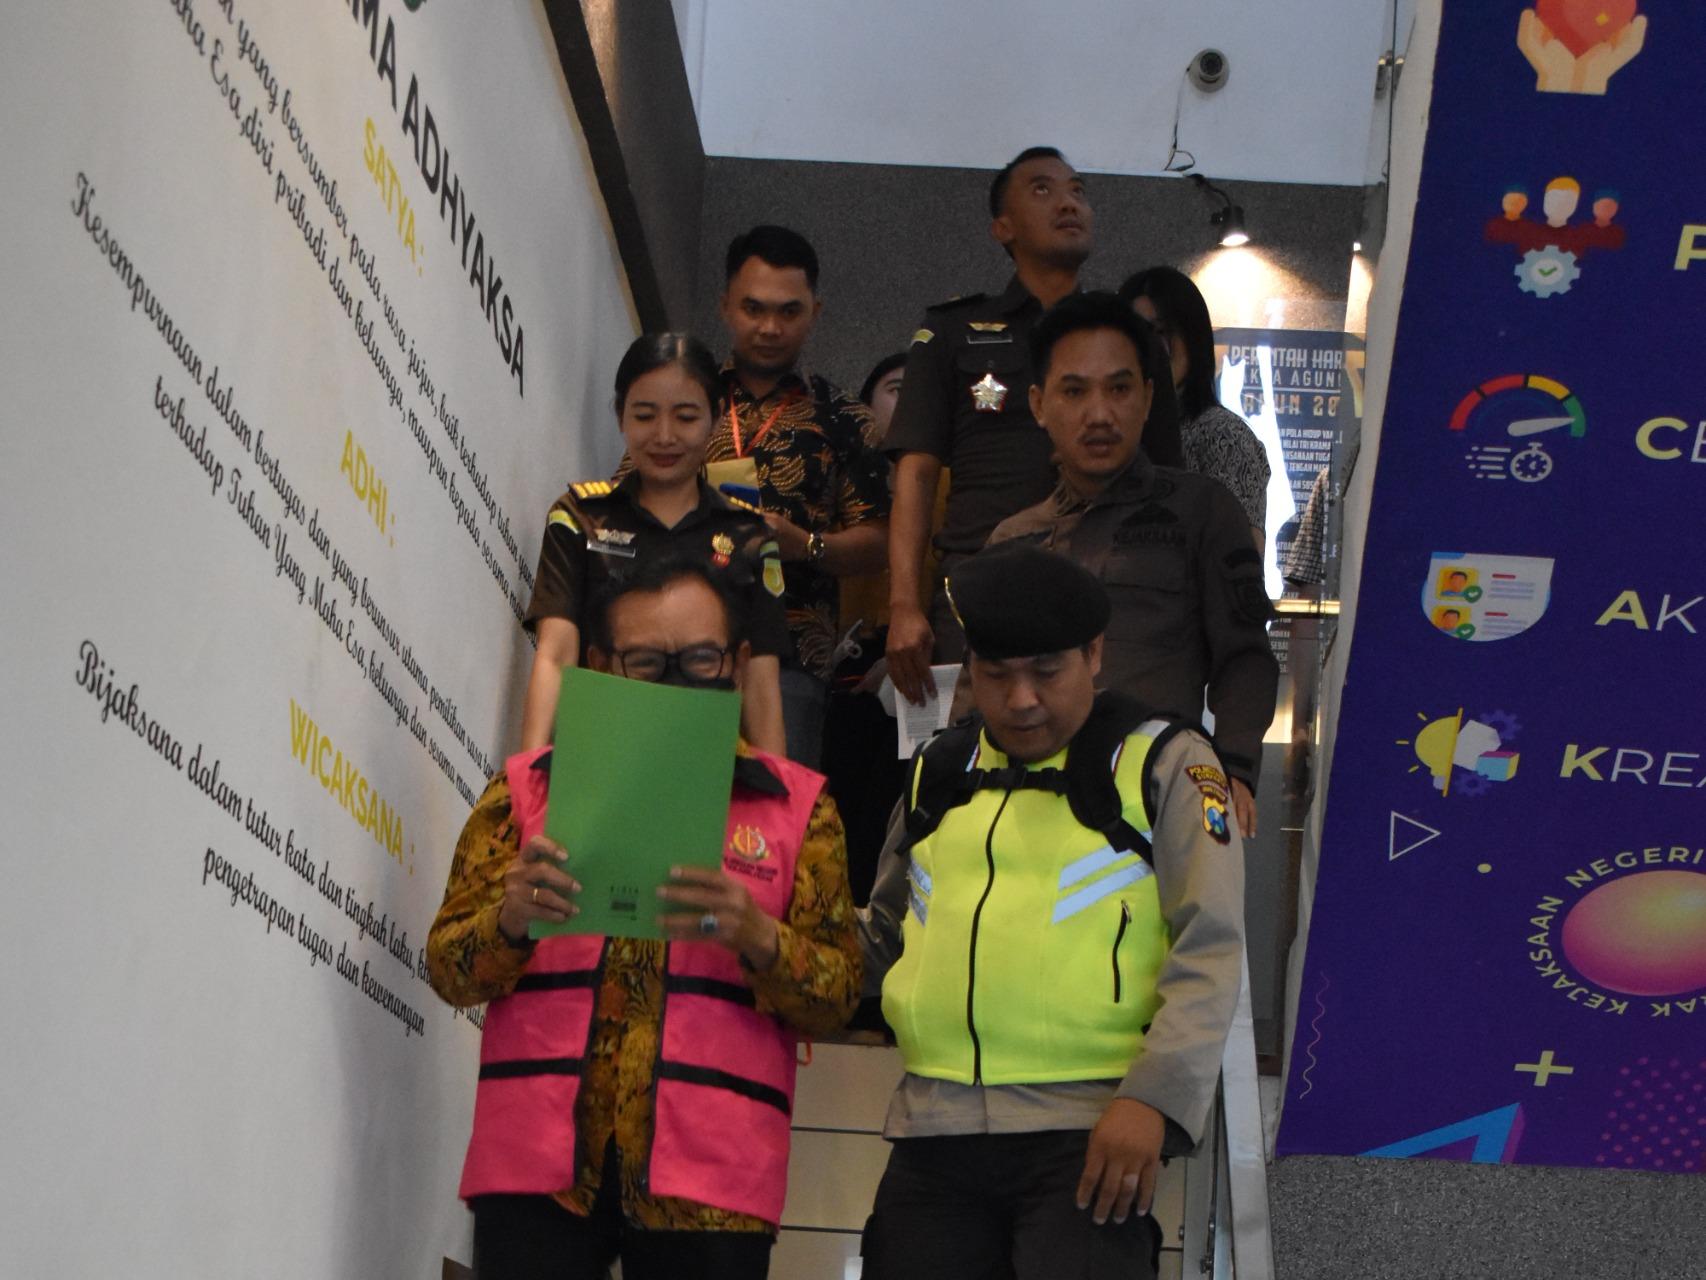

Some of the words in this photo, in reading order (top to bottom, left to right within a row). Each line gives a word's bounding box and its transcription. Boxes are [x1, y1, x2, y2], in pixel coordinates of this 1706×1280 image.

[238, 20, 278, 114] yang
[282, 89, 348, 238] bersumber
[350, 234, 380, 302] pada
[383, 294, 405, 352] rasa
[440, 393, 458, 449] baik
[460, 436, 497, 524] terhadap
[346, 0, 397, 112] MA
[402, 72, 524, 398] ADHYAKSA
[71, 172, 202, 385] Kesempurnaan
[205, 366, 252, 453] dalam
[255, 430, 305, 526] bertugas
[308, 508, 331, 560] dan
[331, 549, 359, 607] yang
[361, 577, 400, 656] berunsur
[401, 645, 428, 695] utama
[430, 685, 466, 746] pemilikan
[467, 736, 488, 771] rasa
[275, 170, 327, 271] pribadi
[328, 257, 352, 318] dan
[408, 408, 447, 490] maupun
[449, 472, 480, 547] kepada
[481, 539, 509, 598] sesama
[154, 375, 223, 496] terhadap
[227, 468, 270, 549] Tuhan
[275, 524, 306, 604] Yang
[309, 576, 343, 642] Maha
[369, 650, 409, 727] keluarga
[410, 706, 427, 748] dan
[428, 738, 455, 784] sesama
[76, 639, 184, 771] Bijaksana
[188, 744, 242, 822] dalam
[245, 798, 281, 856] tutur
[284, 829, 315, 886] kata
[318, 861, 343, 909] dan
[345, 887, 387, 948] tingkah
[203, 848, 295, 938] pengetrapan
[298, 913, 333, 967] tugas
[336, 941, 359, 987] dan
[361, 960, 424, 1037] kewenangan
[1559, 743, 1706, 789] KRE
[1565, 846, 1704, 888] NEGERI
[1526, 895, 1629, 1015] KEJAKSAAN
